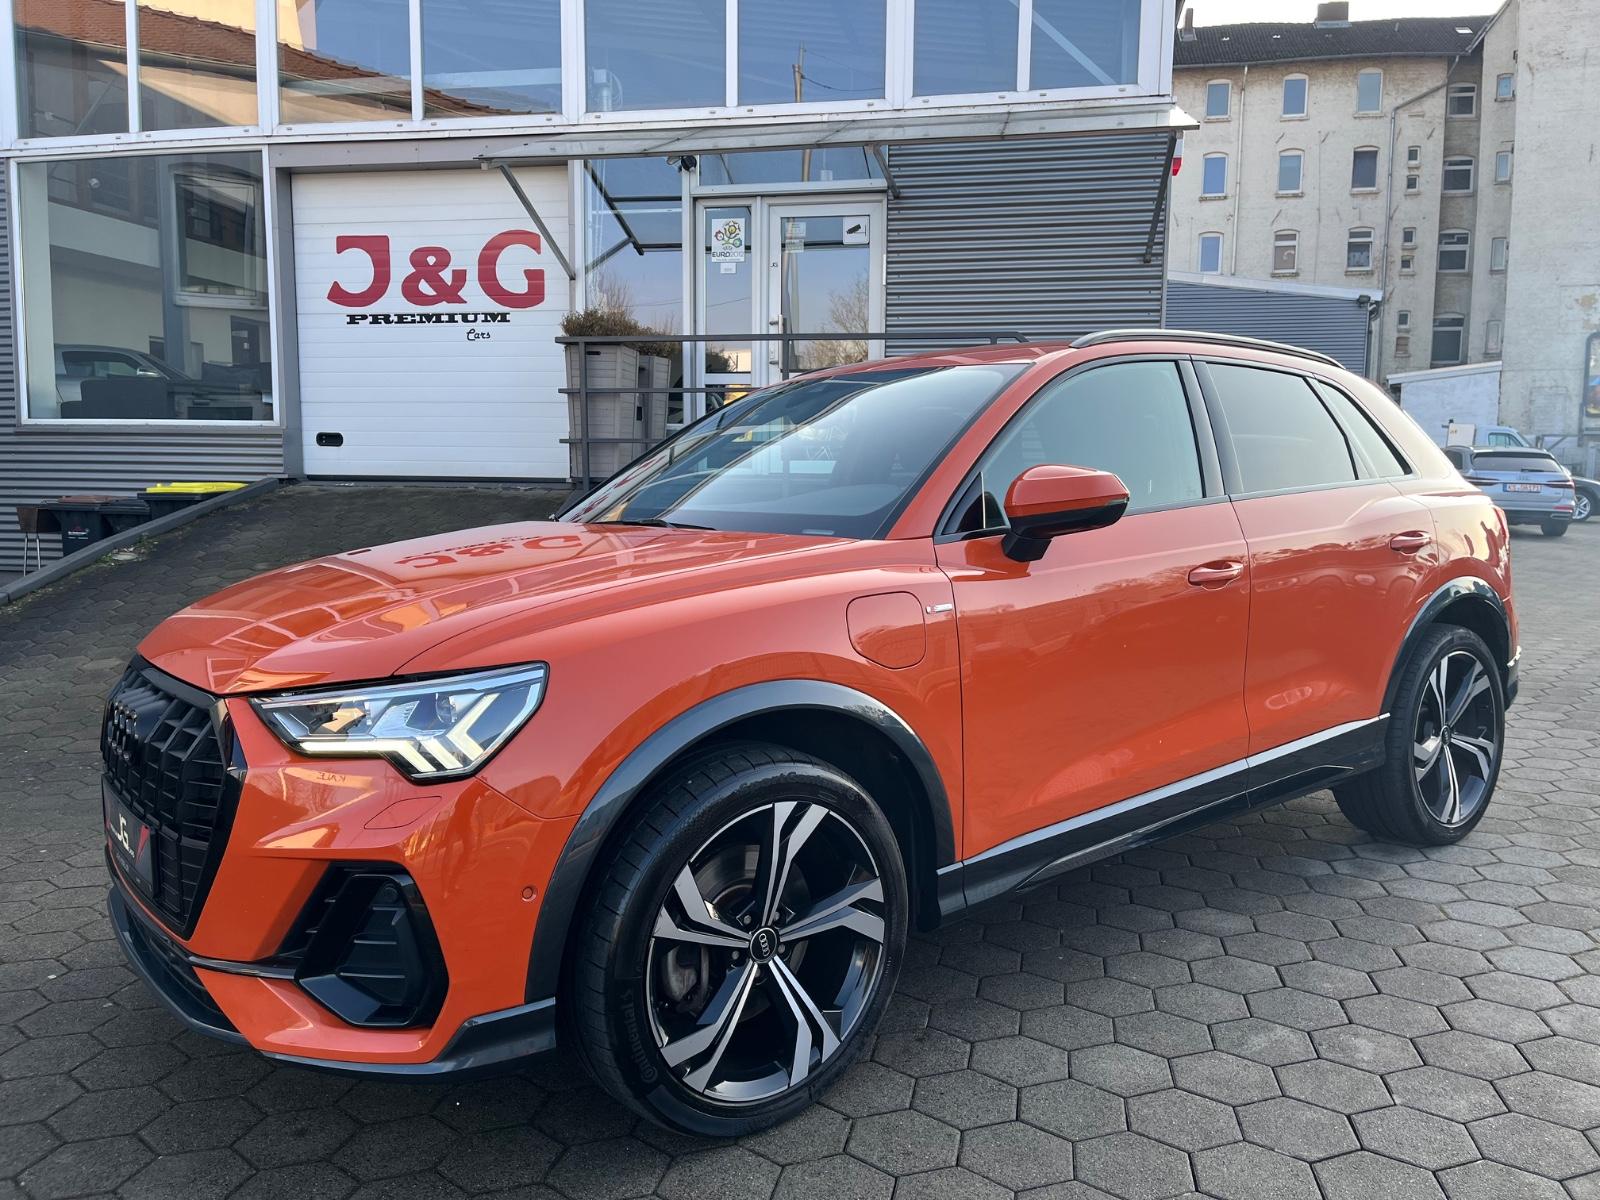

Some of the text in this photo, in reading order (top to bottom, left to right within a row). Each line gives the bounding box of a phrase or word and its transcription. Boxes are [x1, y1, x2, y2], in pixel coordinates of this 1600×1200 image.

[326, 229, 545, 309] J&G
[346, 312, 511, 325] PREMIUM
[466, 328, 491, 341] Cars
